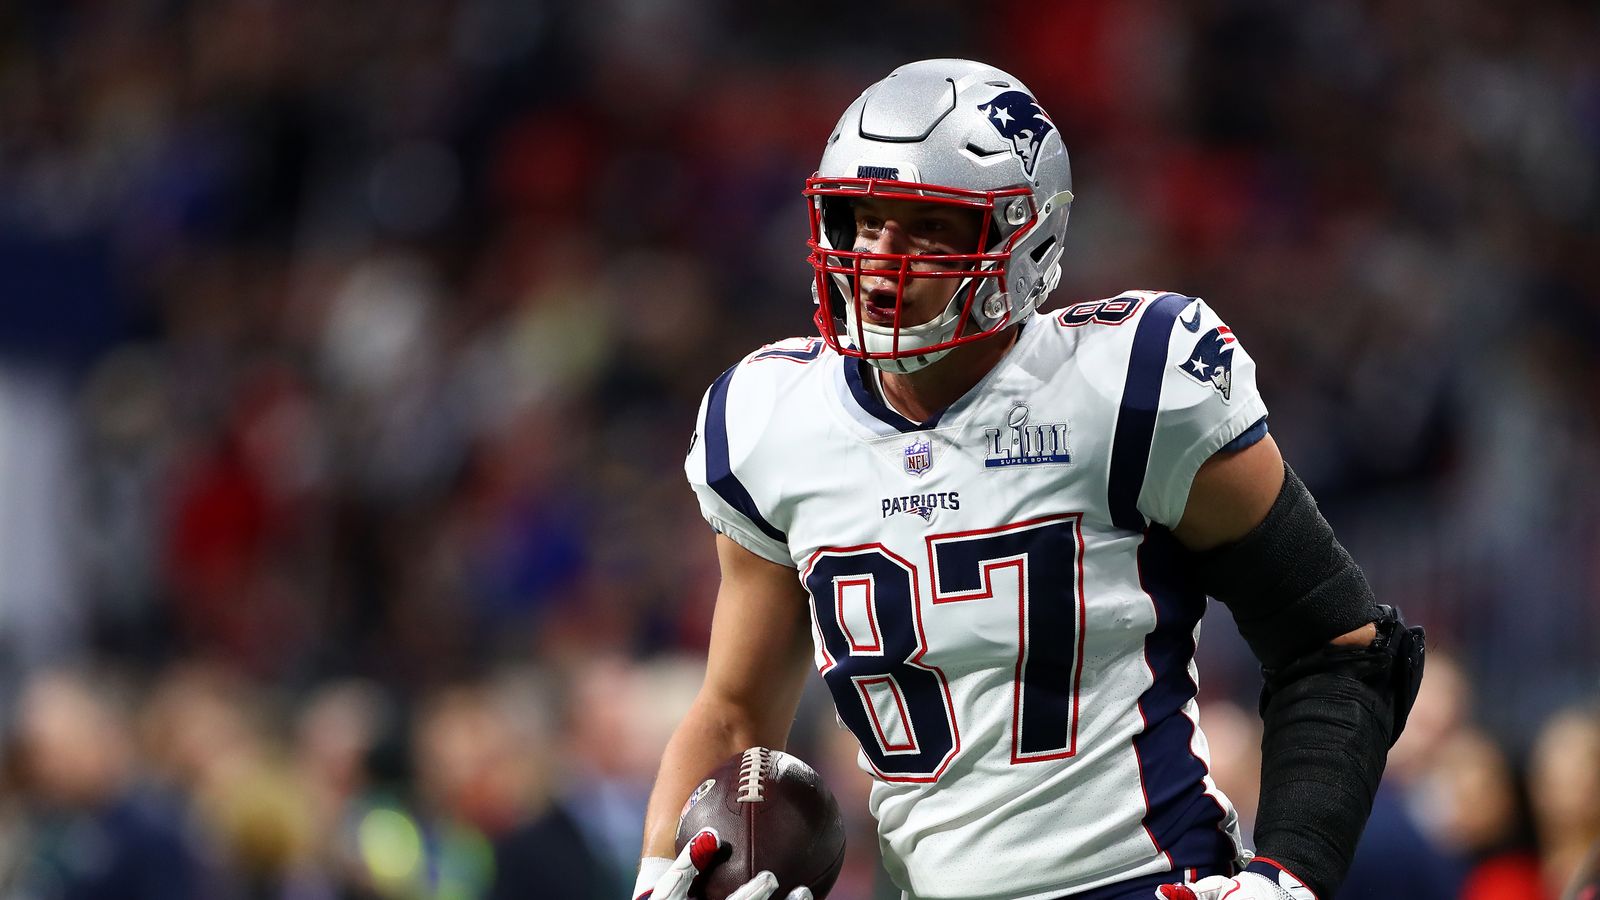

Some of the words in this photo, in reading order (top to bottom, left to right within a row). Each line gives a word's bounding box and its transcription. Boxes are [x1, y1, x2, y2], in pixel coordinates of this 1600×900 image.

[857, 166, 899, 181] PATRIOTS
[907, 454, 928, 470] NFL
[1000, 457, 1028, 465] SUPER
[881, 491, 960, 518] PATRIOTS
[800, 512, 1086, 783] 87
